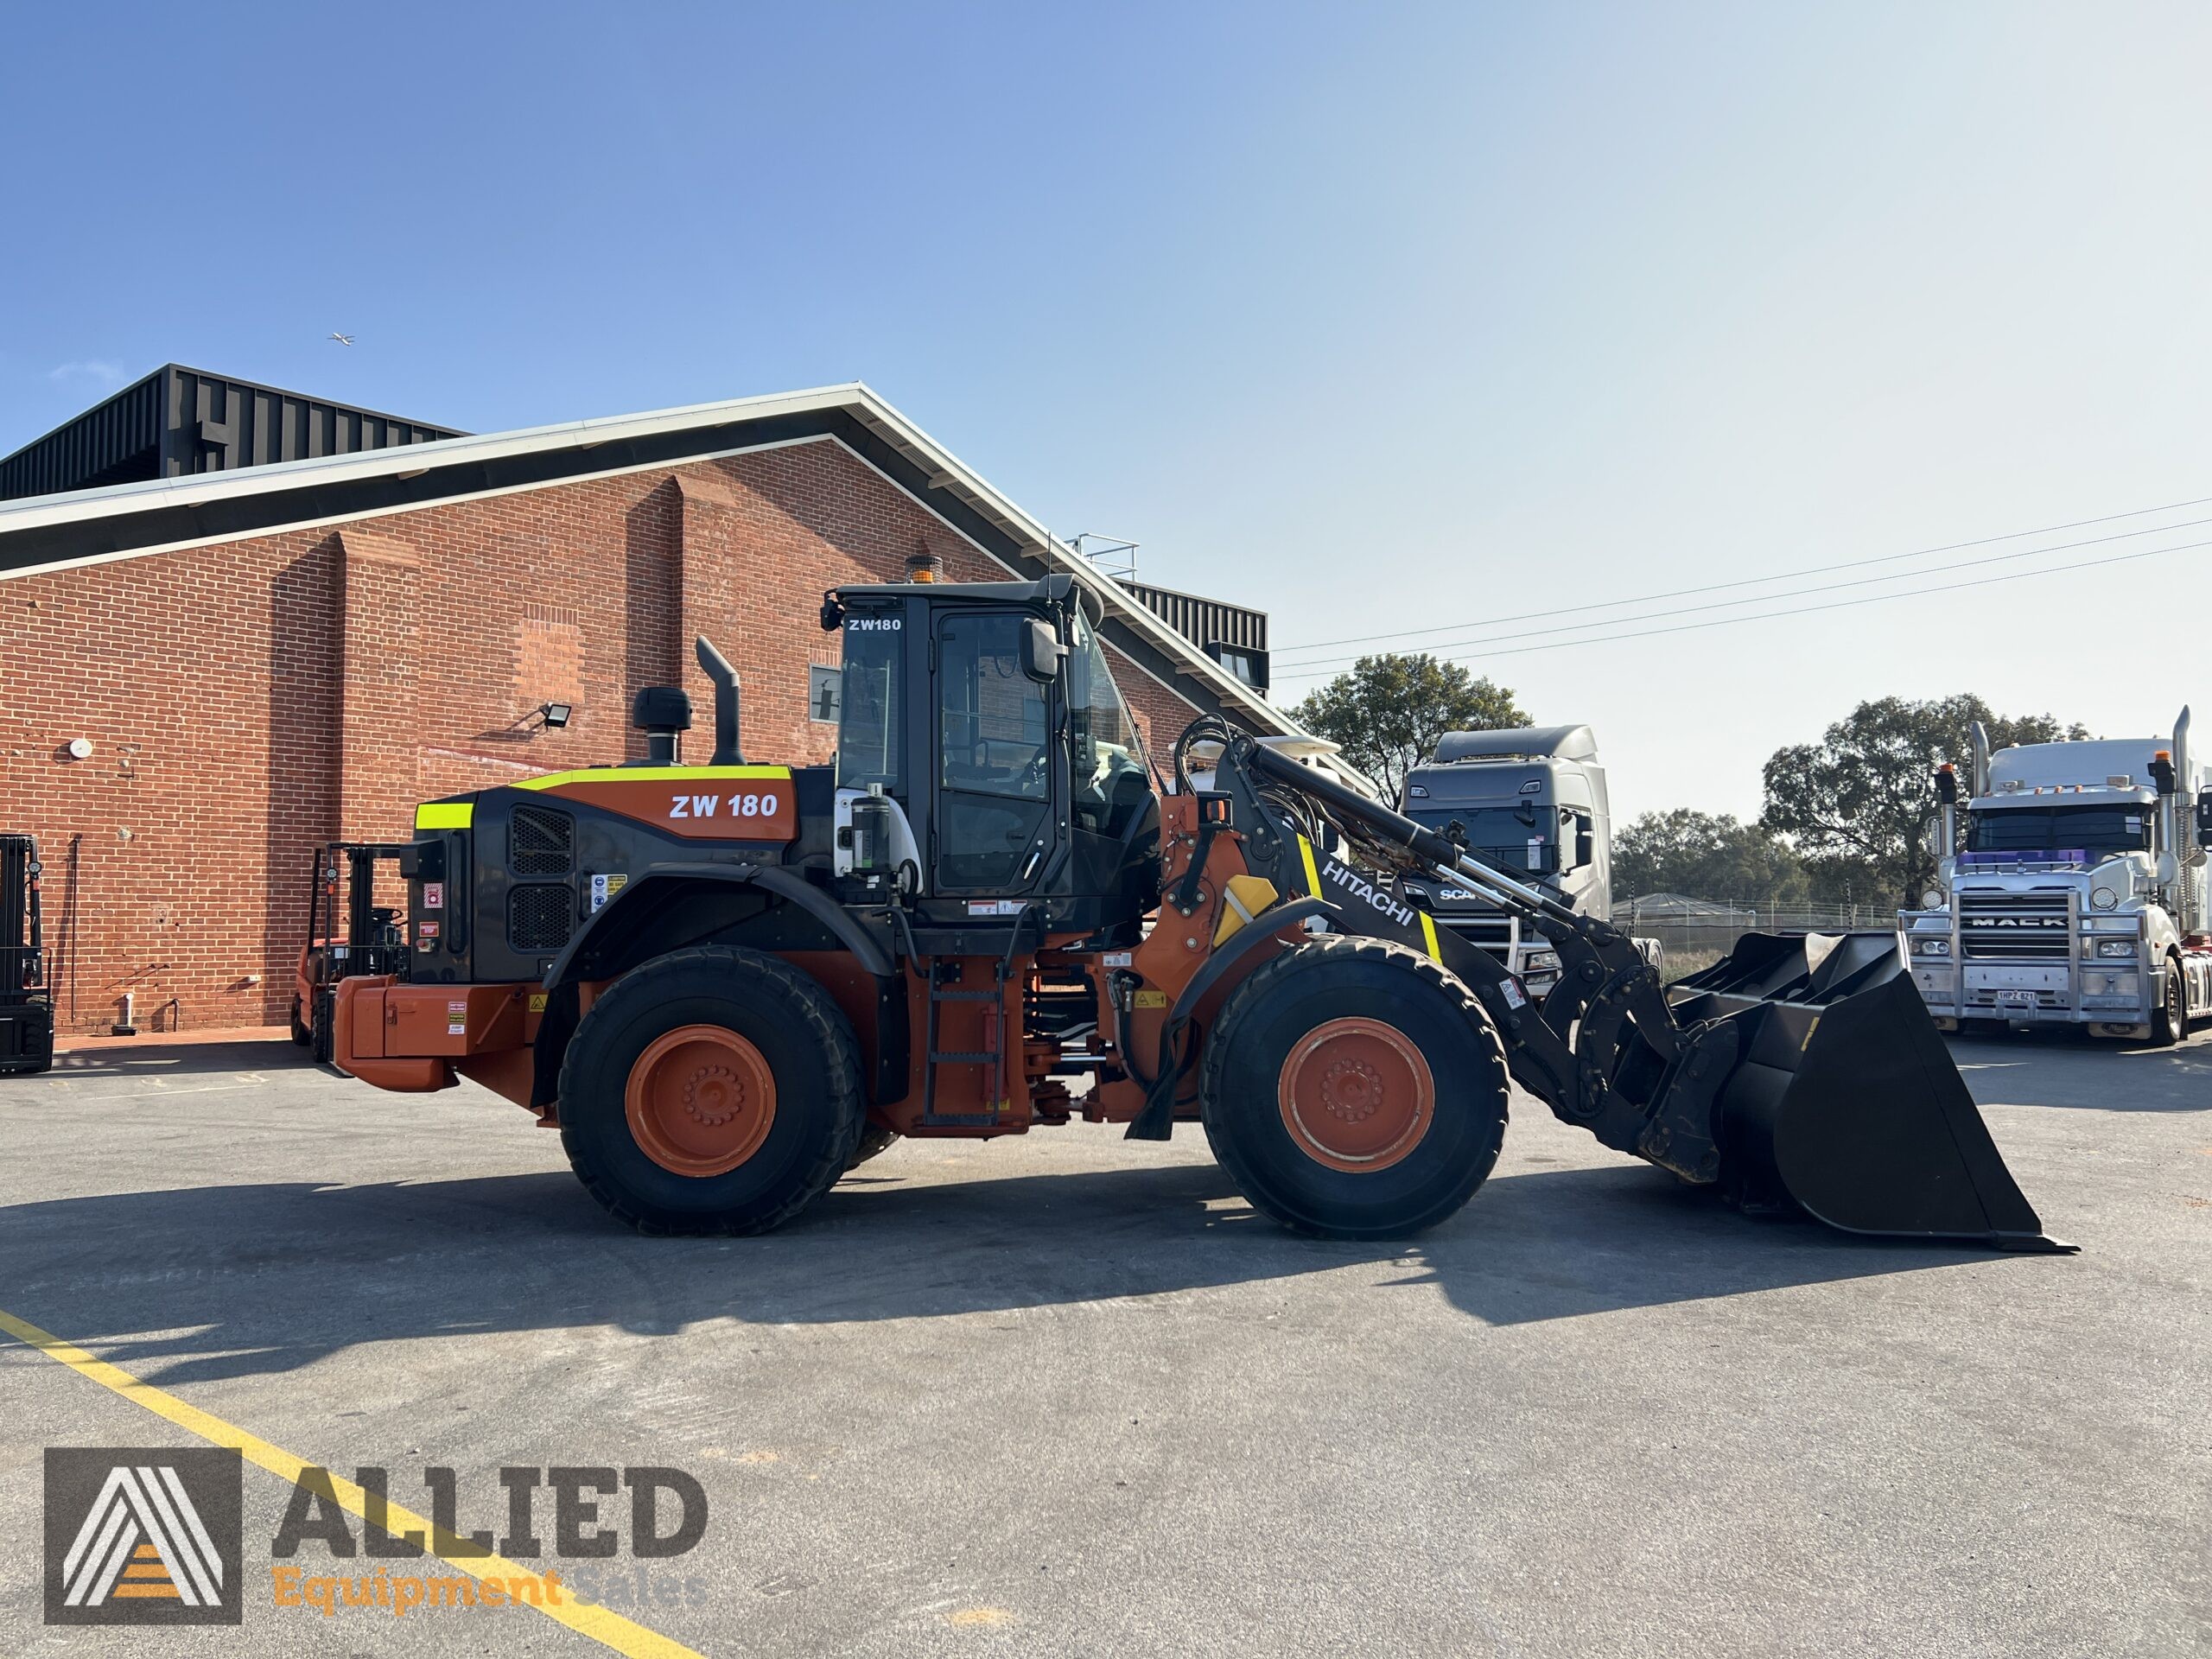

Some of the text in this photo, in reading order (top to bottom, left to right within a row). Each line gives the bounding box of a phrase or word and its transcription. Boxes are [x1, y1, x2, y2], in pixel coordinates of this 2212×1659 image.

[849, 619, 901, 631] ZW180
[670, 794, 778, 818] ZW 180
[1322, 860, 1414, 927] HITACHI
